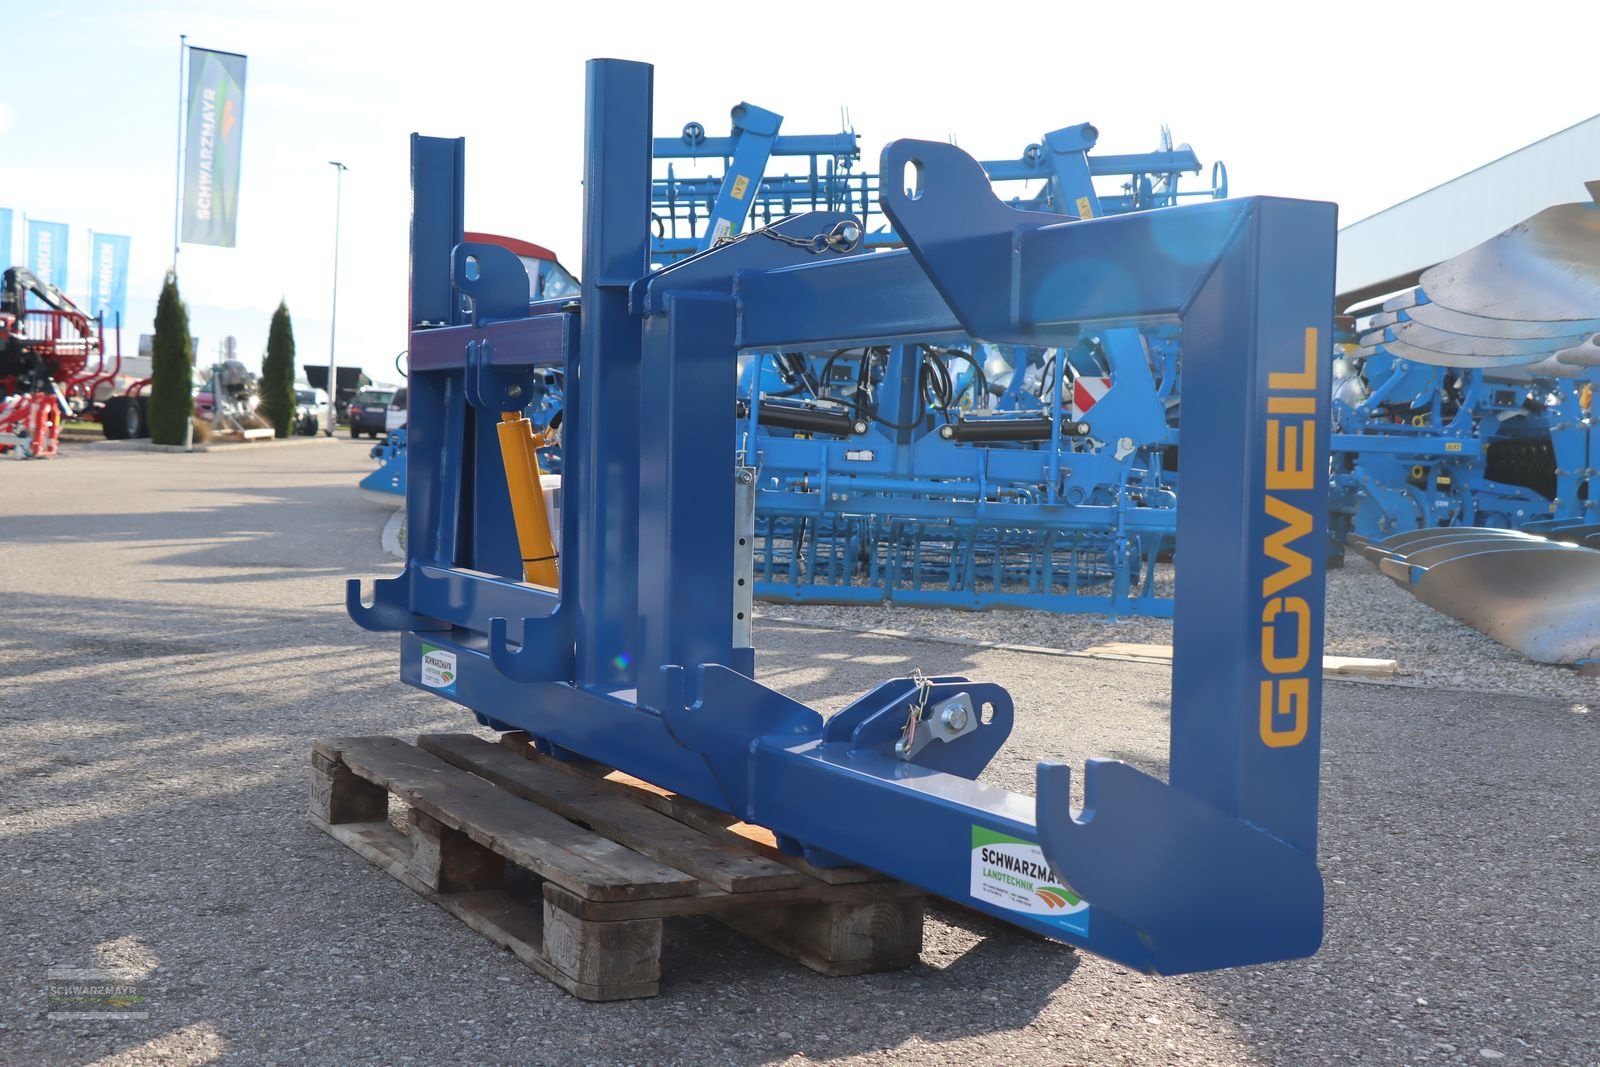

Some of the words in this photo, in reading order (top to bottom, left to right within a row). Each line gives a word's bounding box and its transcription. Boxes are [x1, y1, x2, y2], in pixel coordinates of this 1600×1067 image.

[197, 88, 217, 220] SCHWARZMAYR
[37, 231, 52, 284] EMKEN
[98, 243, 114, 303] LEMKEN
[981, 847, 1060, 885] SCHWARZMA
[983, 867, 1034, 892] LANDTECHNIK
